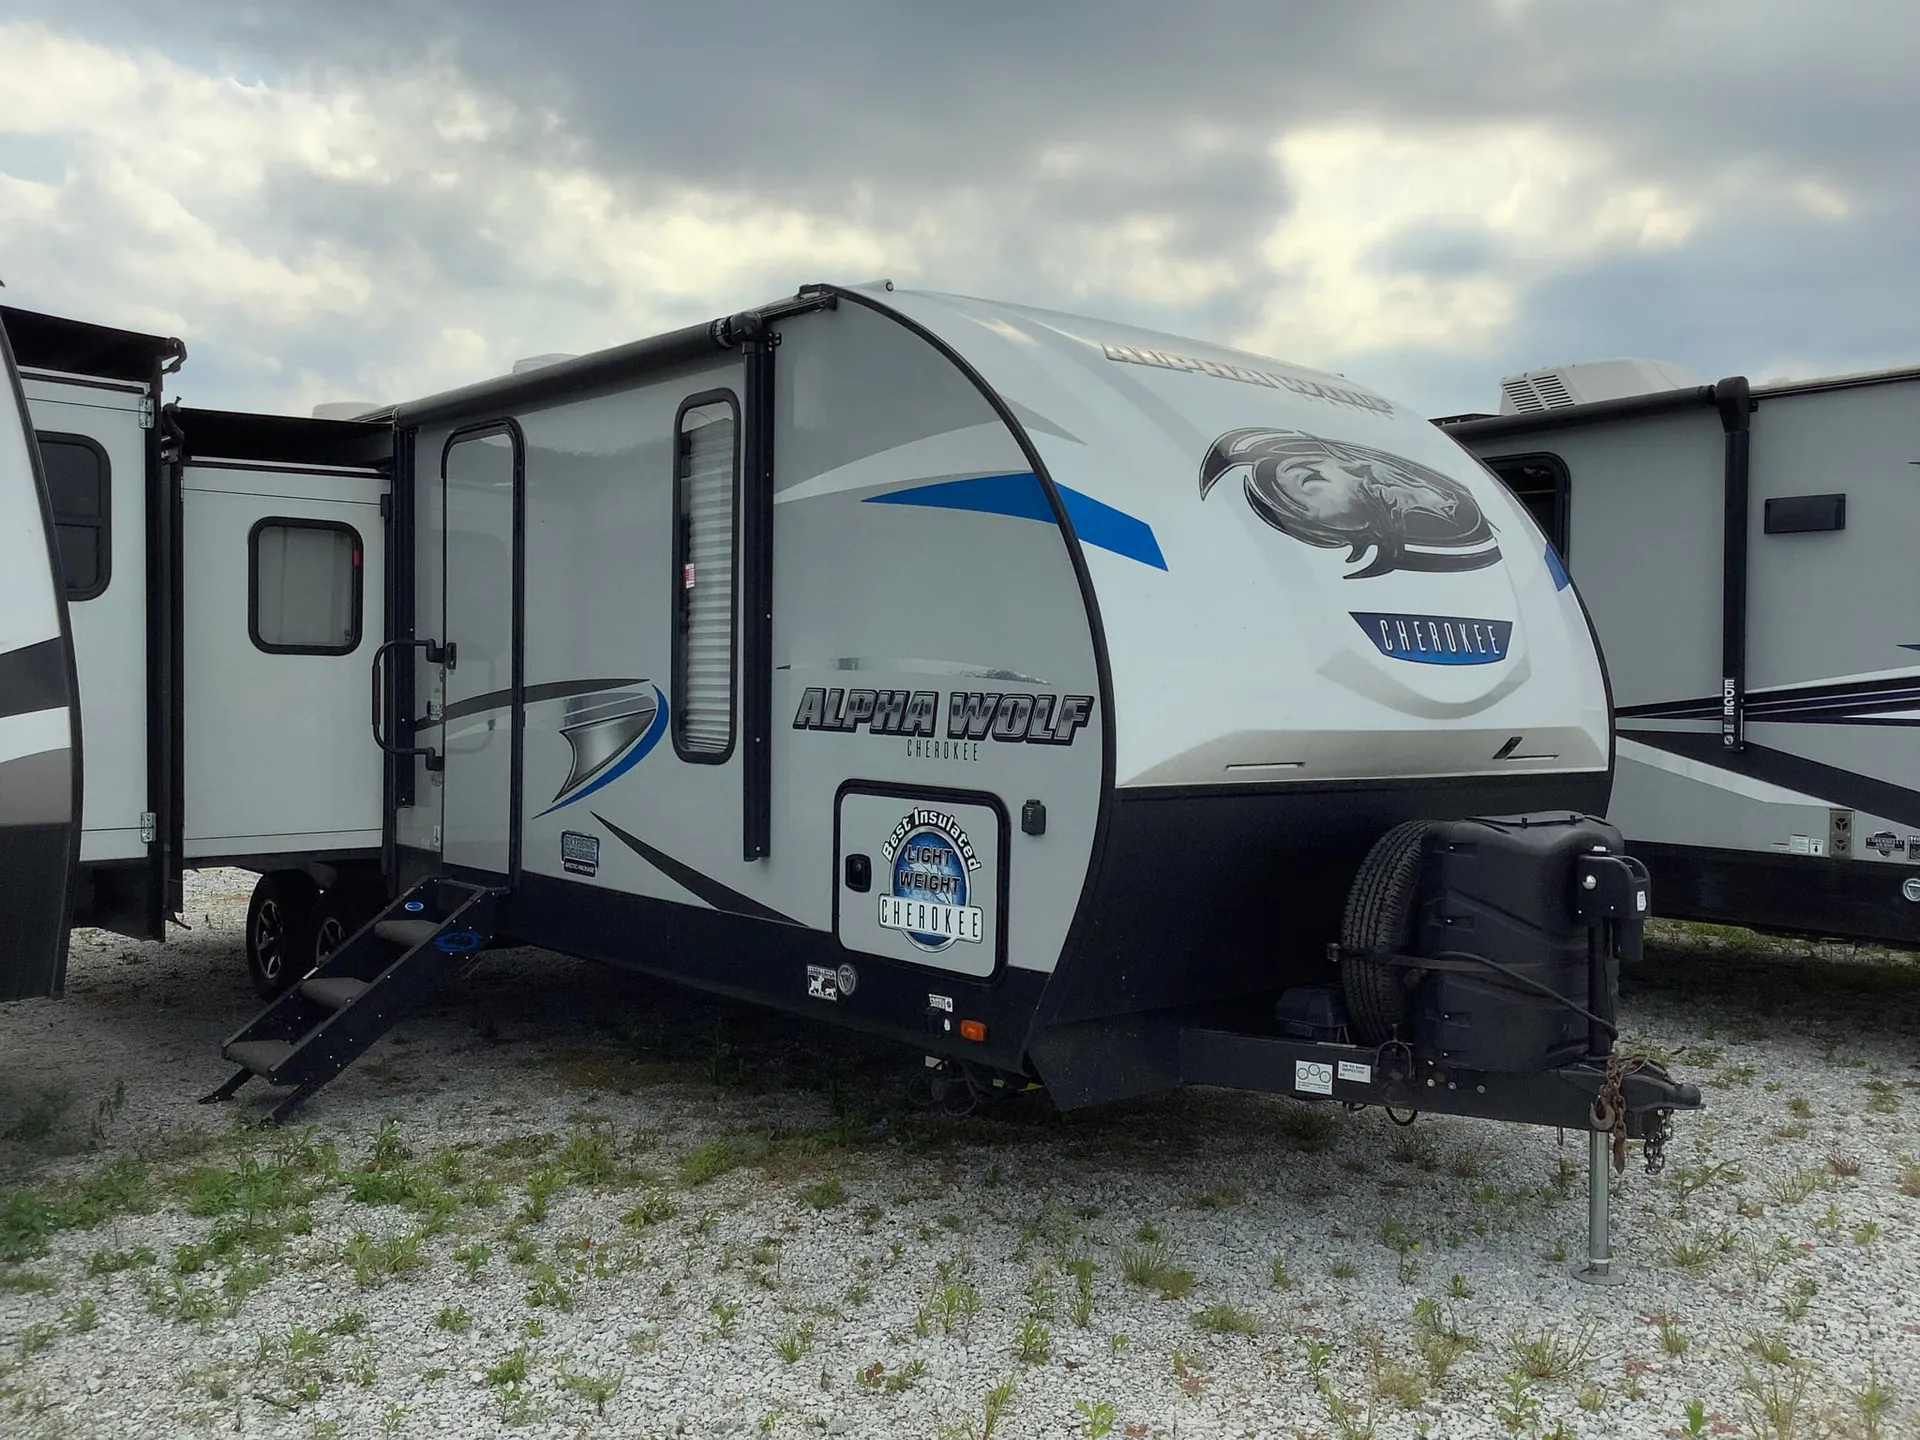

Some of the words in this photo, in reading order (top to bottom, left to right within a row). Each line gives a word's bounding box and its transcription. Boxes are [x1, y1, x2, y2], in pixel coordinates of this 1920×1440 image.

[1380, 619, 1500, 654] CHEROKEE
[1724, 679, 1735, 715] EDGE
[793, 687, 939, 738] ALPHA
[947, 692, 1095, 746] WOLF
[907, 739, 979, 762] CHEROKEE
[882, 816, 911, 862] Best
[913, 808, 982, 872] Insulated
[906, 845, 953, 866] LIGHT
[900, 870, 961, 893] WEIGHT
[881, 899, 979, 938] CHEROKEE
